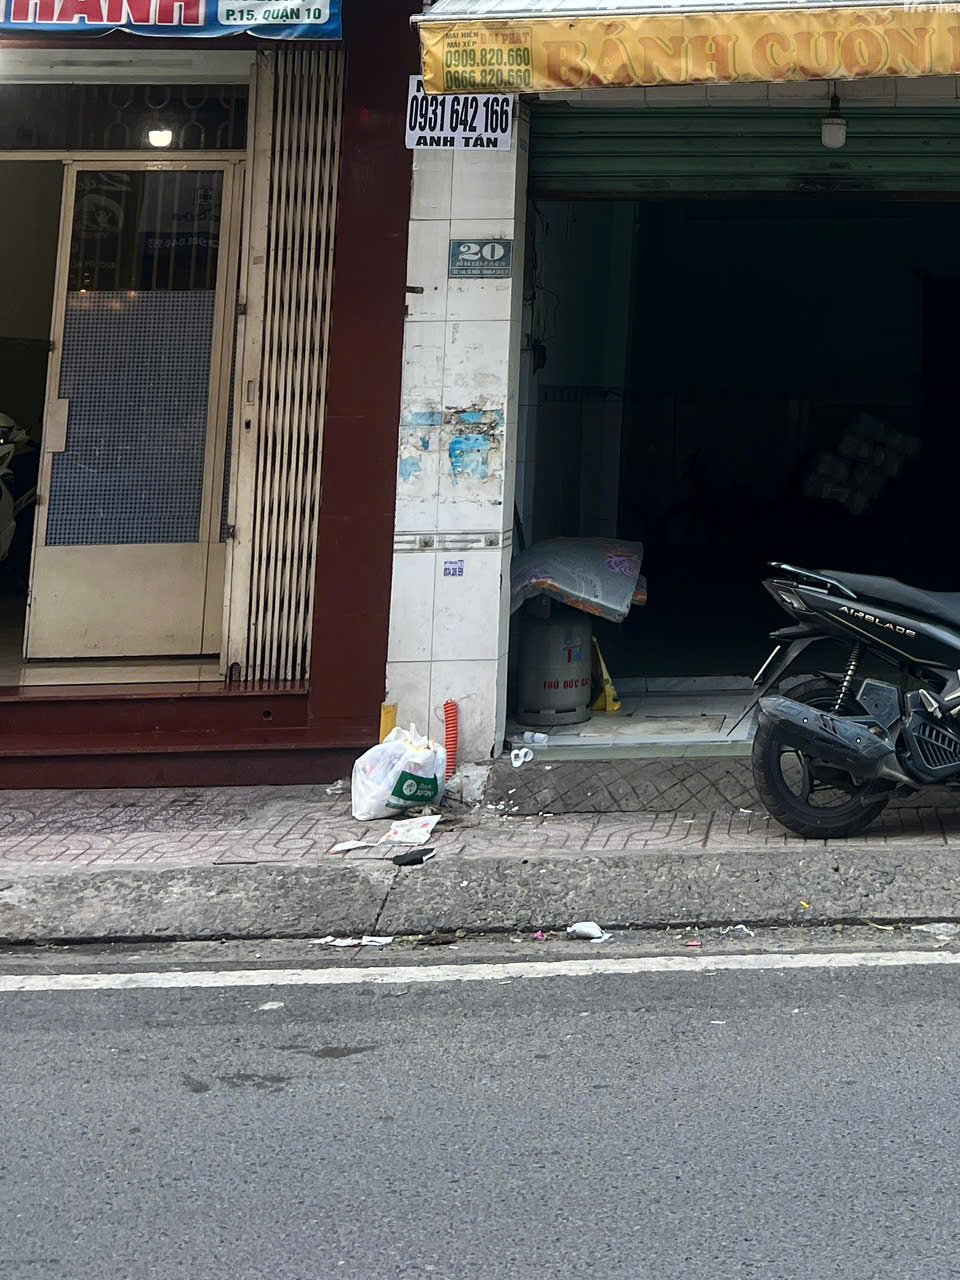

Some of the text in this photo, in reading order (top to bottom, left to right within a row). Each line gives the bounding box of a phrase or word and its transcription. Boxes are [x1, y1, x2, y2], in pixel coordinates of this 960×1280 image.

[226, 7, 322, 22] P.15, QUẬN 10
[445, 48, 531, 68] 0909.820.660
[543, 22, 739, 86] BÁNH
[445, 69, 531, 89] 0866.820.660
[408, 94, 510, 133] 0931 642 166
[415, 136, 455, 147] ANH
[459, 243, 504, 260] 20
